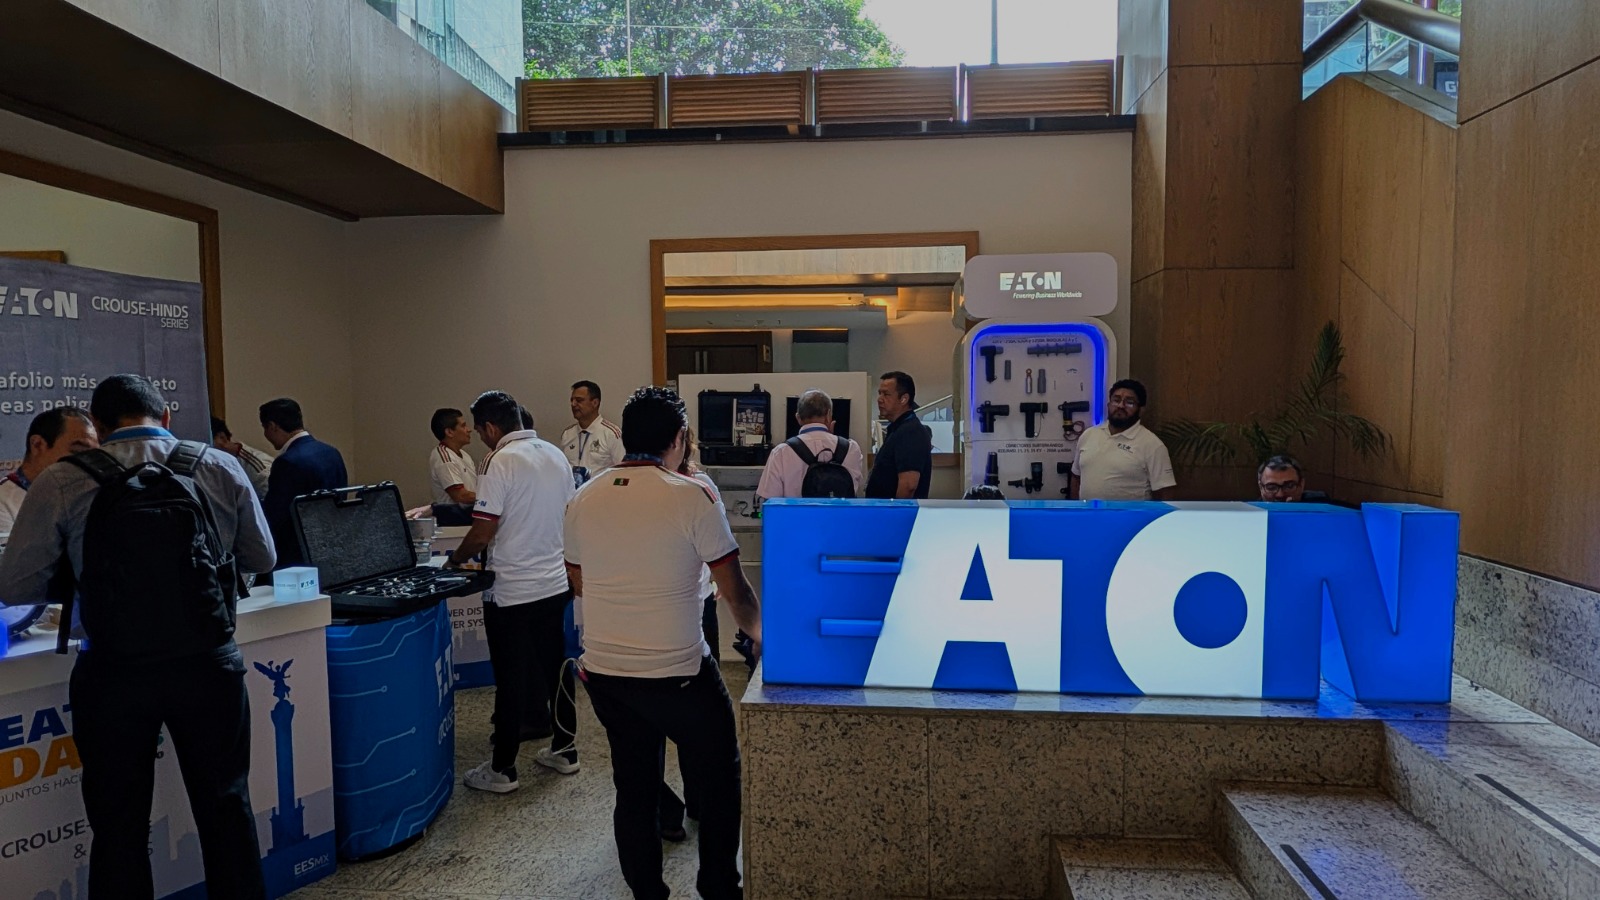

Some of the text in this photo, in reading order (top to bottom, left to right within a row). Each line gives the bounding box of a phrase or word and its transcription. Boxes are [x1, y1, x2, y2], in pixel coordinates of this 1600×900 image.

[999, 271, 1062, 291] EATON
[1035, 291, 1057, 299] Business
[1057, 290, 1083, 298] Worldwide
[91, 295, 189, 319] CROUSE-HINDS
[160, 317, 189, 329] SERIES
[61, 373, 97, 389] más
[762, 500, 1460, 702] EATON
[73, 843, 87, 860] &
